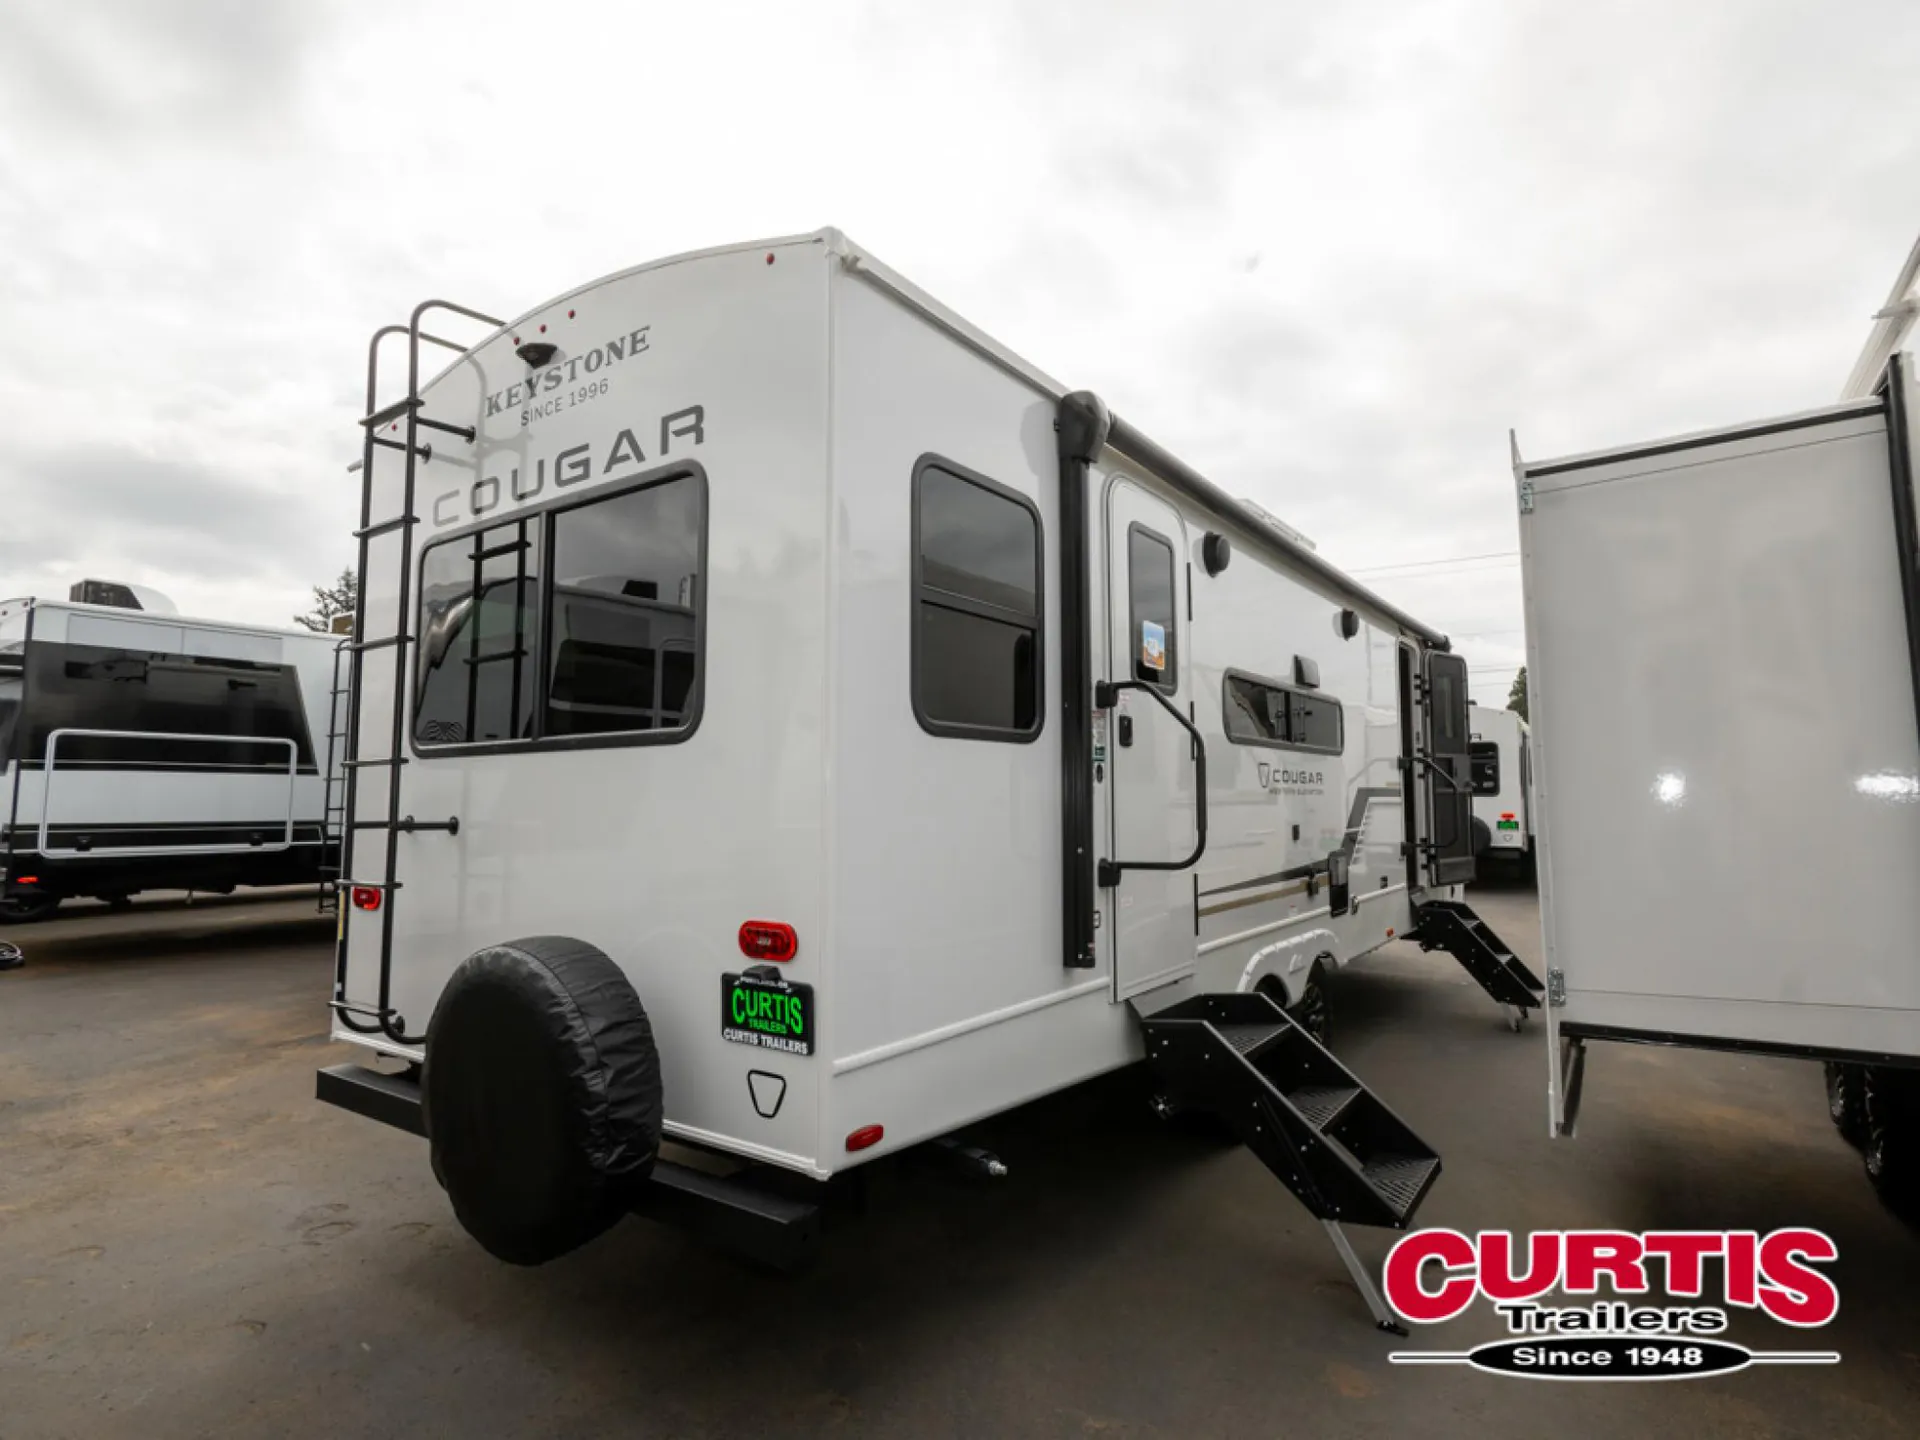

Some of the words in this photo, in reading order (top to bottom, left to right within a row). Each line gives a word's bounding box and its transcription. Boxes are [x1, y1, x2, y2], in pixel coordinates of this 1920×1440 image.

[485, 325, 651, 418] KEYSTONE
[520, 397, 563, 427] SINCE
[569, 378, 609, 408] 1996
[433, 404, 705, 528] COUGAR
[1272, 769, 1323, 785] COUGAR
[732, 987, 803, 1034] CURTIS
[723, 1027, 758, 1045] CURTIS
[760, 1034, 808, 1055] TRAILERS
